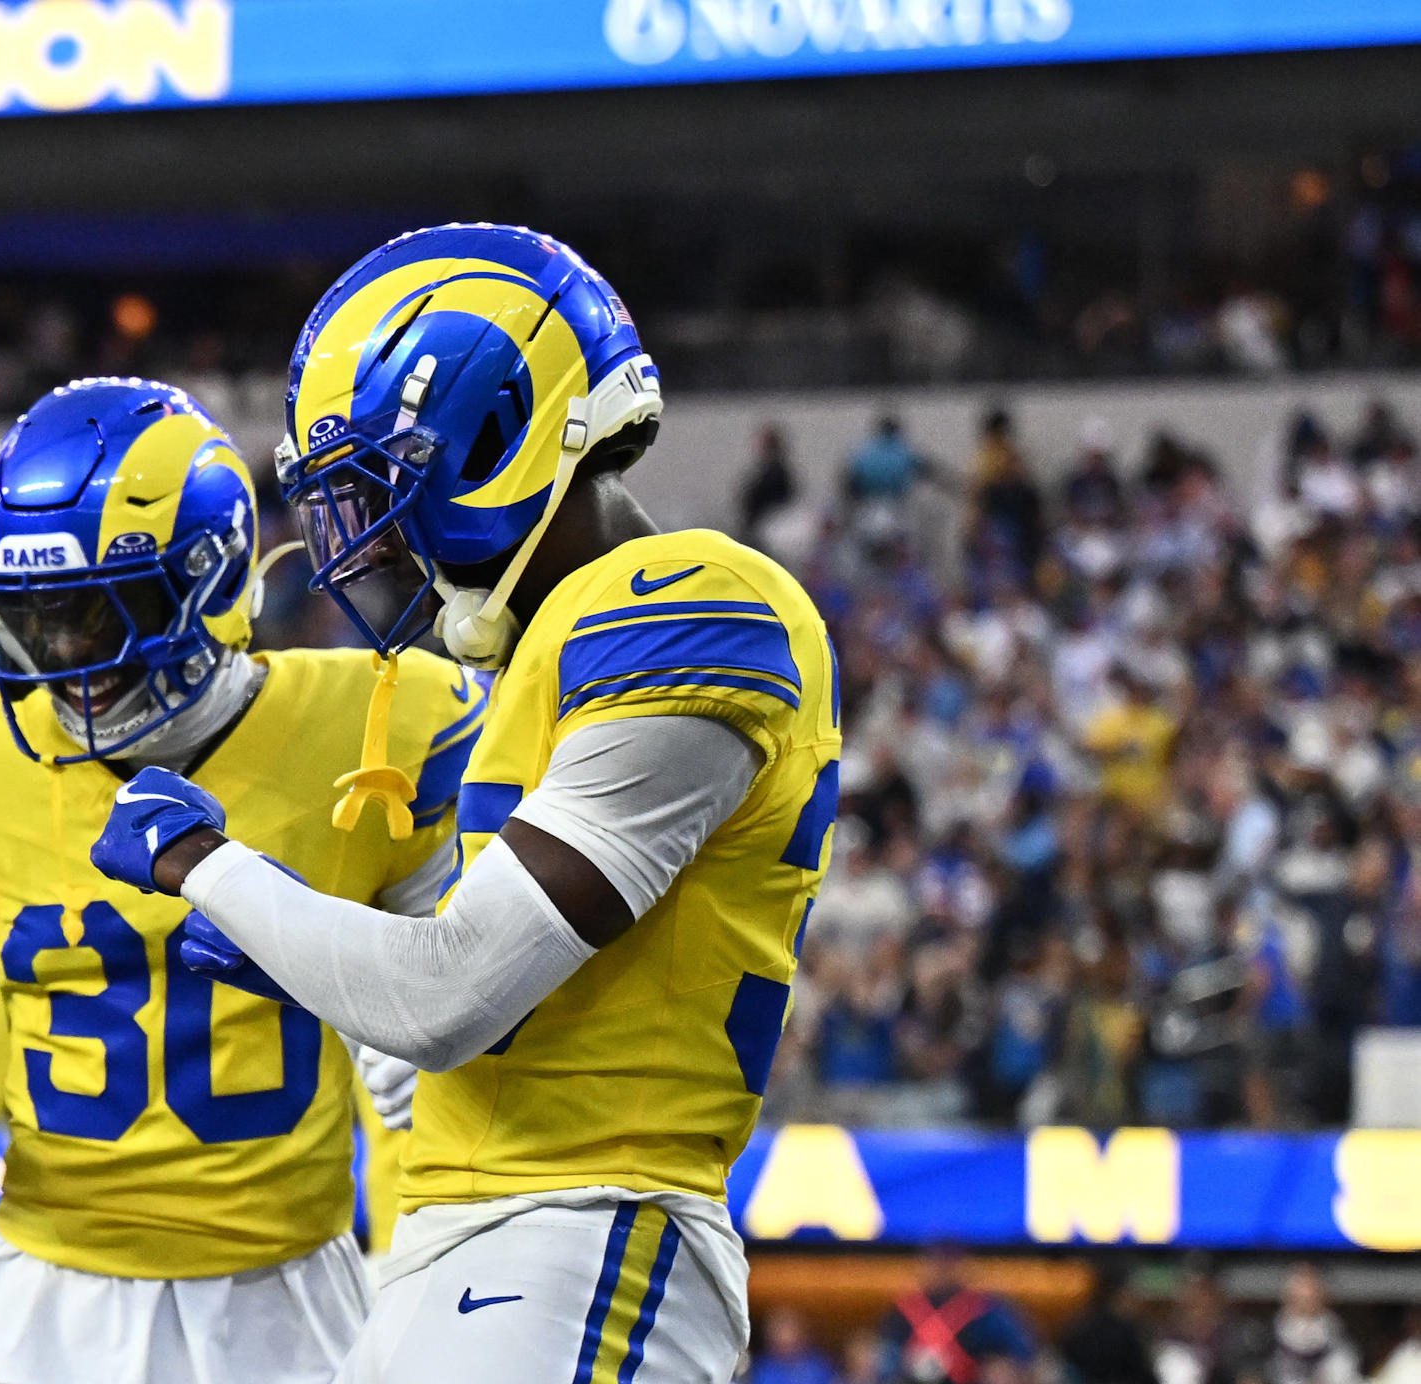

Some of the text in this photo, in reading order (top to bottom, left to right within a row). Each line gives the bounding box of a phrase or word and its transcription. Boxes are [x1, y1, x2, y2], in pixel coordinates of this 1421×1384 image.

[309, 426, 346, 449] OAKLEY
[3, 546, 66, 567] RAMS
[1, 899, 322, 1145] 30
